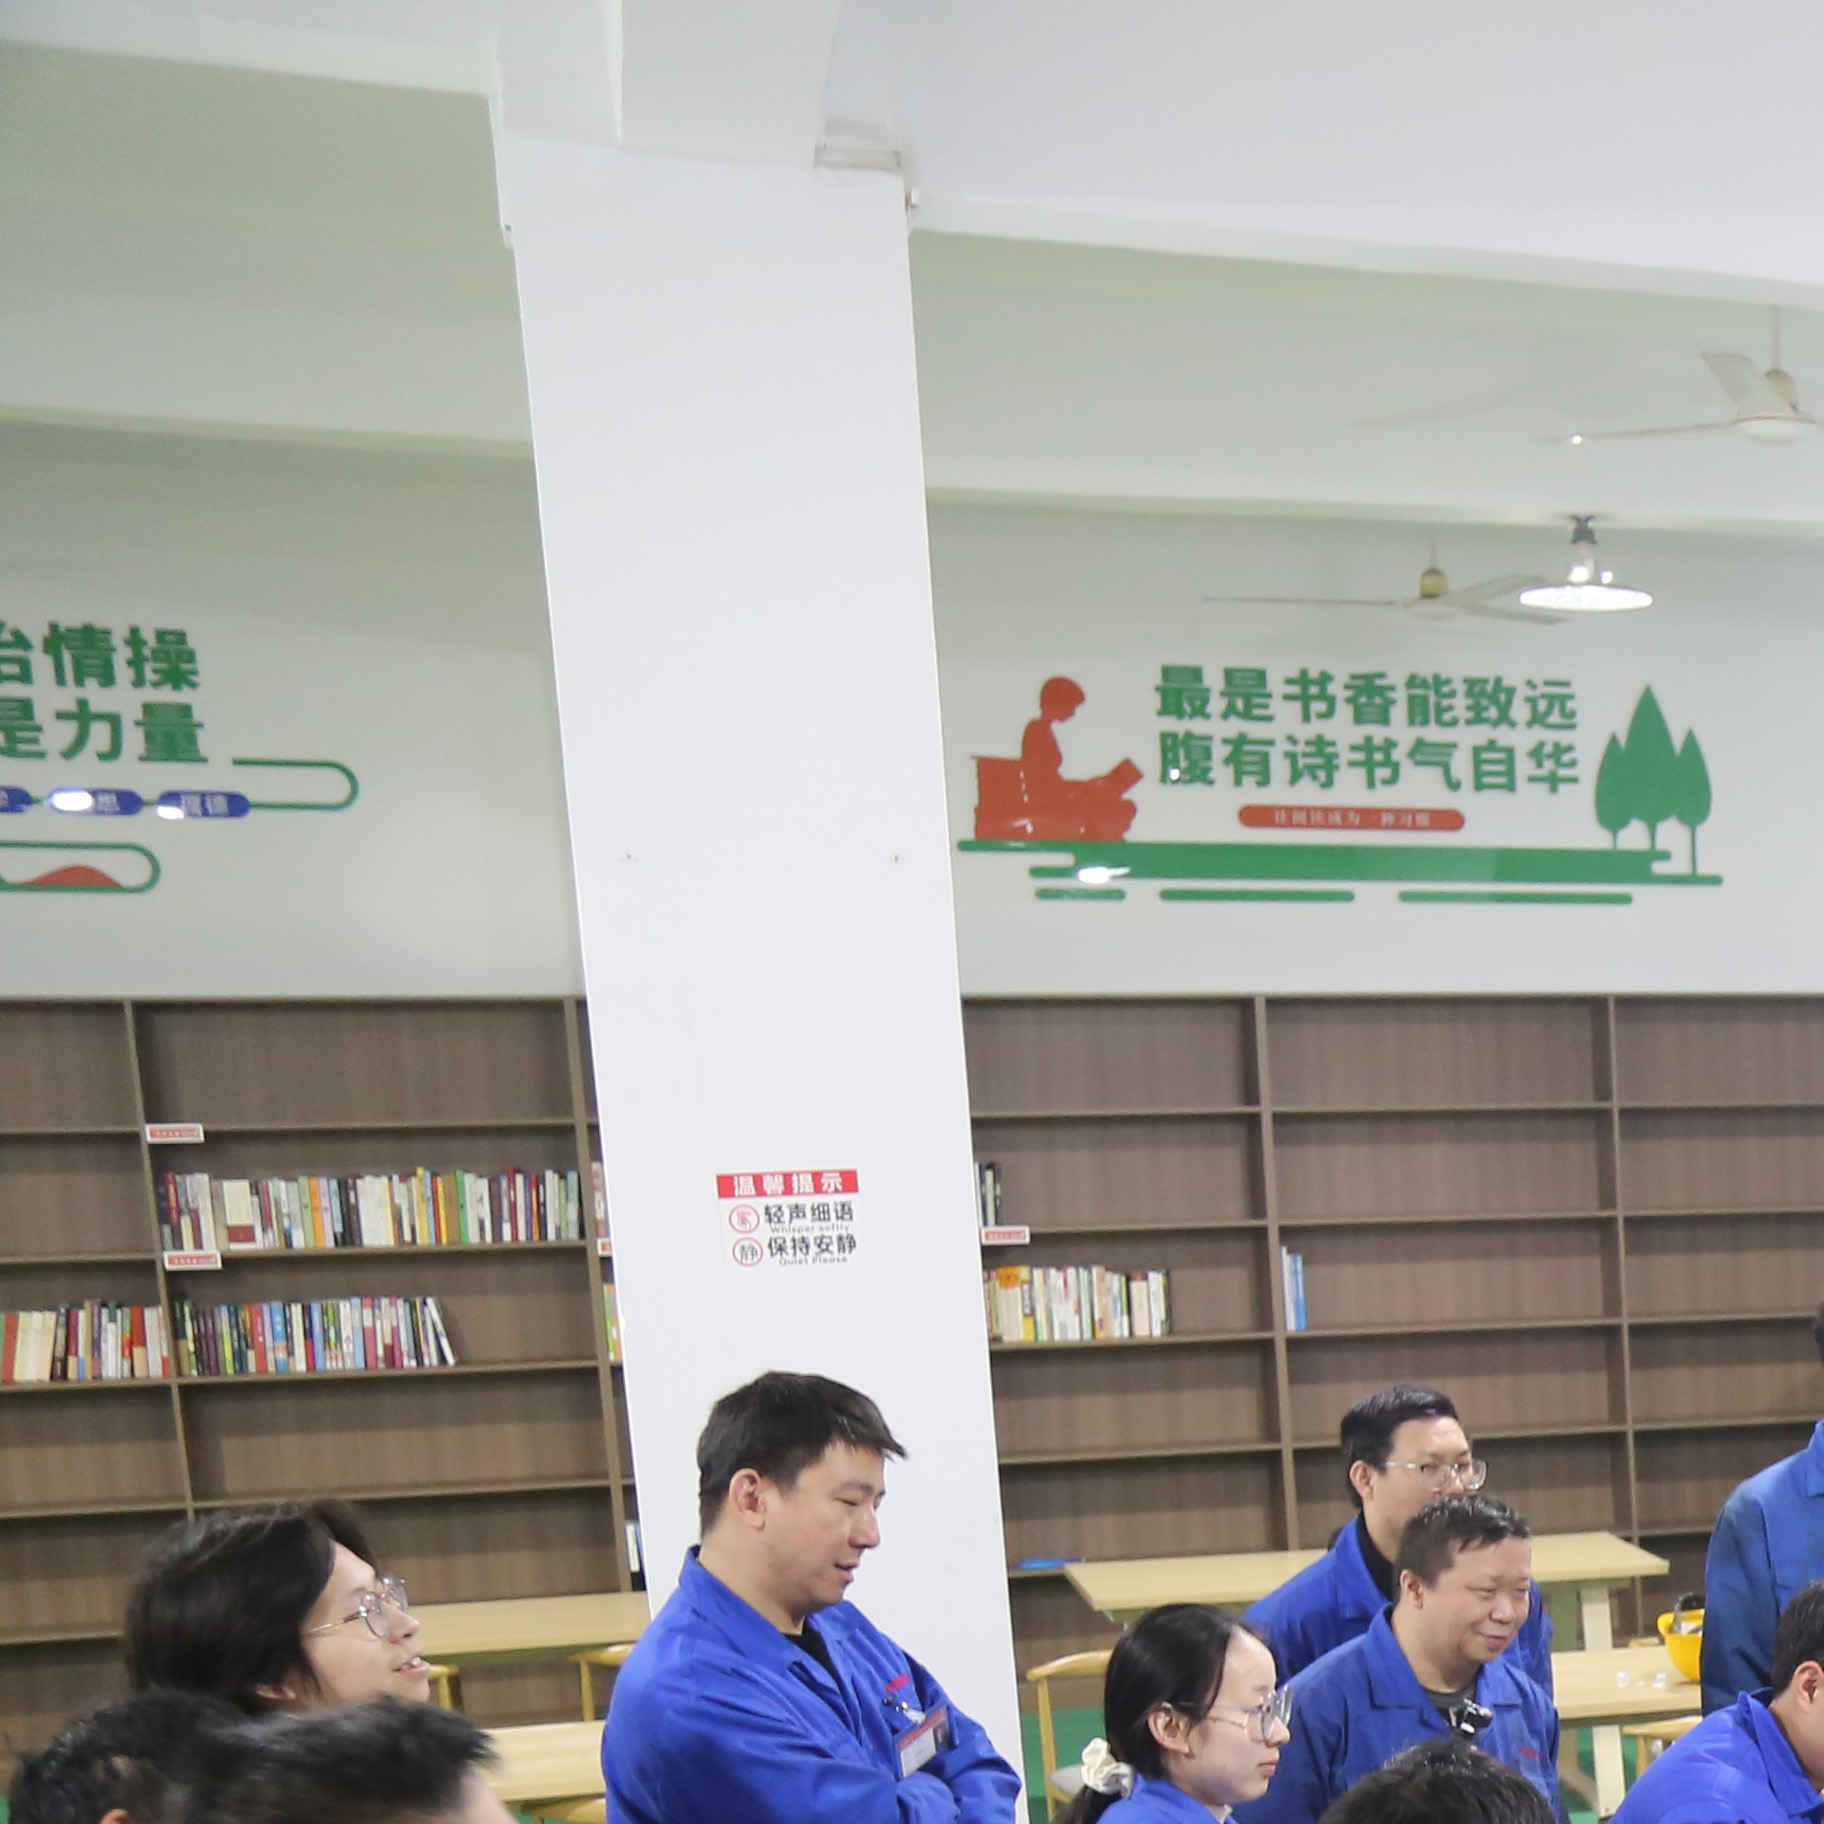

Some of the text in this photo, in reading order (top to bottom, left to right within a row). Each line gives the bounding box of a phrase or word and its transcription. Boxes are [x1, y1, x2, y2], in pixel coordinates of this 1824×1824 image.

[1154, 665, 1580, 730] 最是书香能致远
[1159, 731, 1581, 795] 腹有诗书气自华
[733, 1172, 843, 1196] 温馨提示
[764, 1201, 853, 1224] 轻声细语
[770, 1223, 850, 1235] Whisper softly
[767, 1233, 857, 1257] 保持安静
[779, 1255, 848, 1267] Quiet Please
